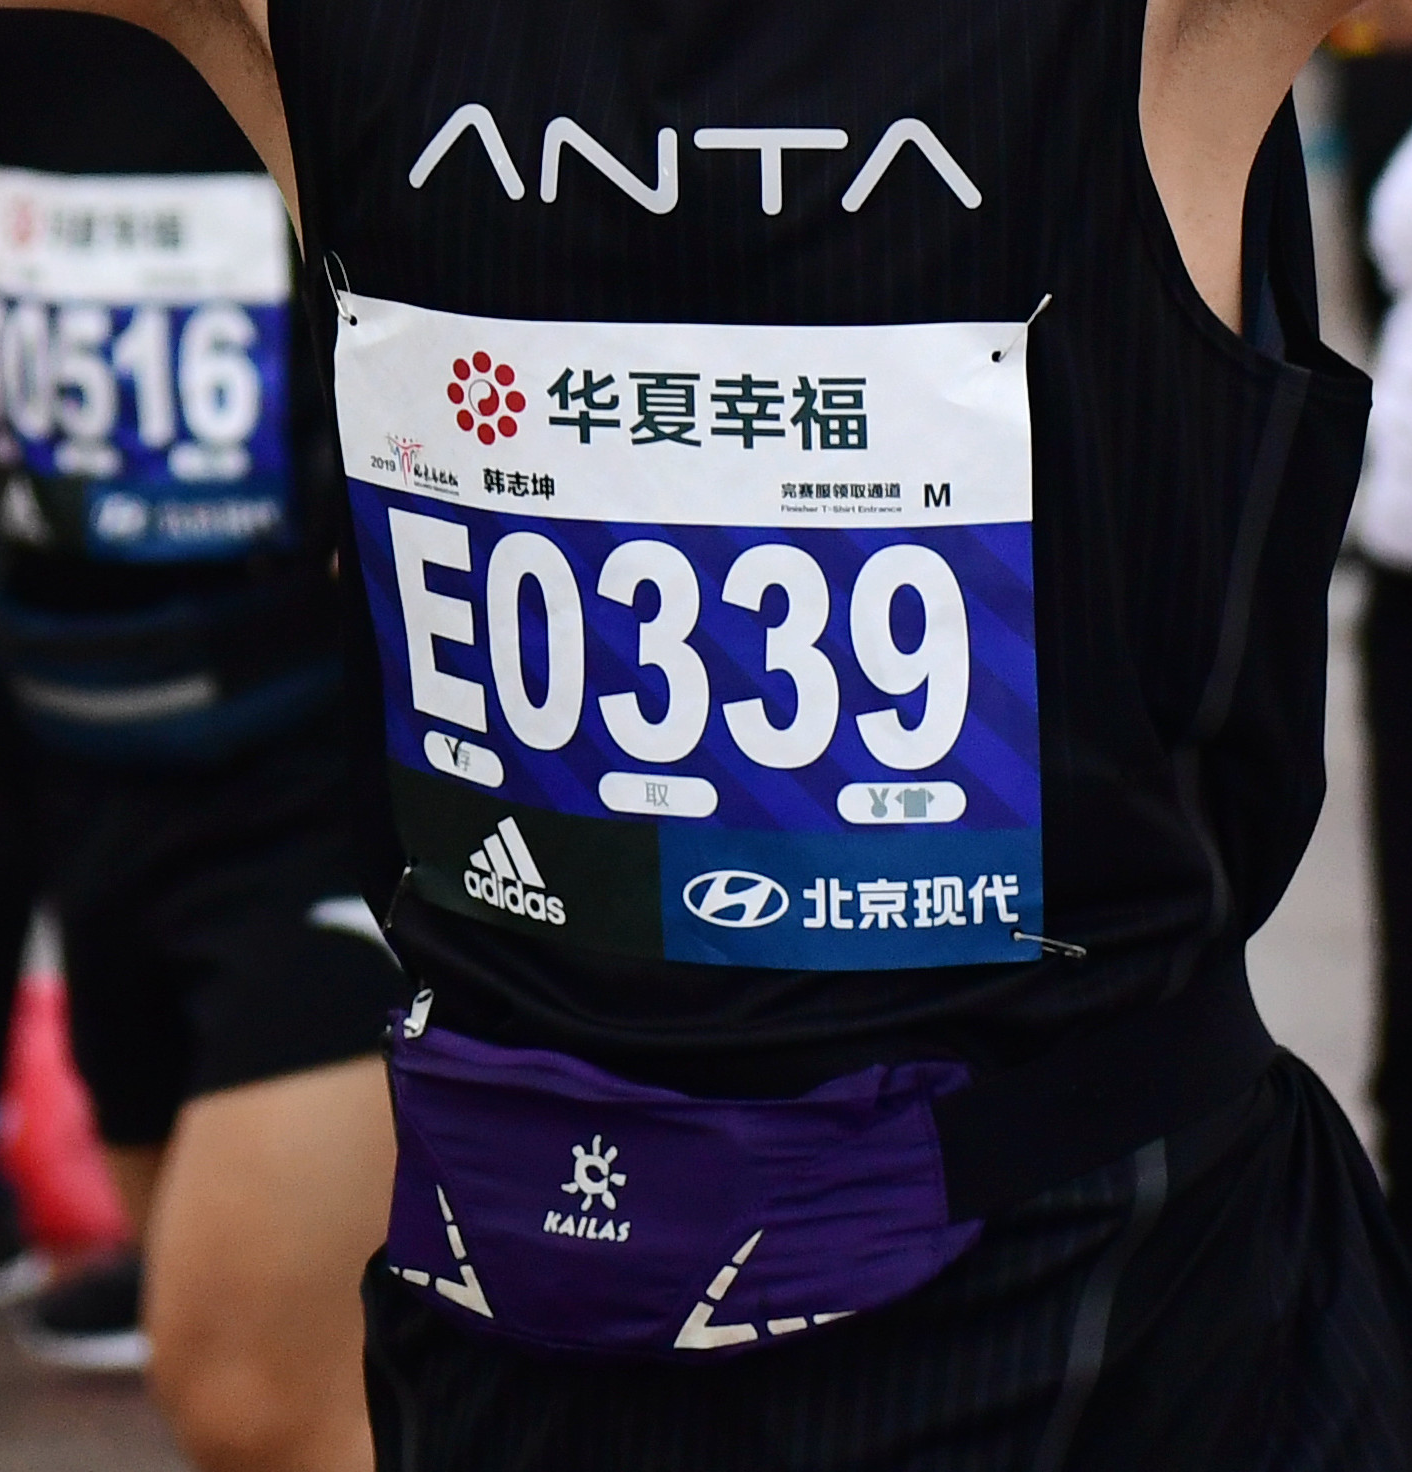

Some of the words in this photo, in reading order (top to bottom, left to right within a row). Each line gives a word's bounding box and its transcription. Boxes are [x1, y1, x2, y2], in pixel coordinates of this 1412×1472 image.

[409, 103, 982, 215] ANTA
[546, 368, 868, 451] 华夏幸福
[370, 455, 396, 472] 2019
[483, 468, 555, 501] 韩志坤
[781, 482, 901, 499] 完赛服领取通道
[924, 483, 951, 508] M
[388, 506, 970, 770] E0339
[645, 781, 670, 807] 取
[464, 869, 567, 926] adidas
[802, 874, 1020, 929] 北京现代
[543, 1210, 631, 1243] KAILAS
